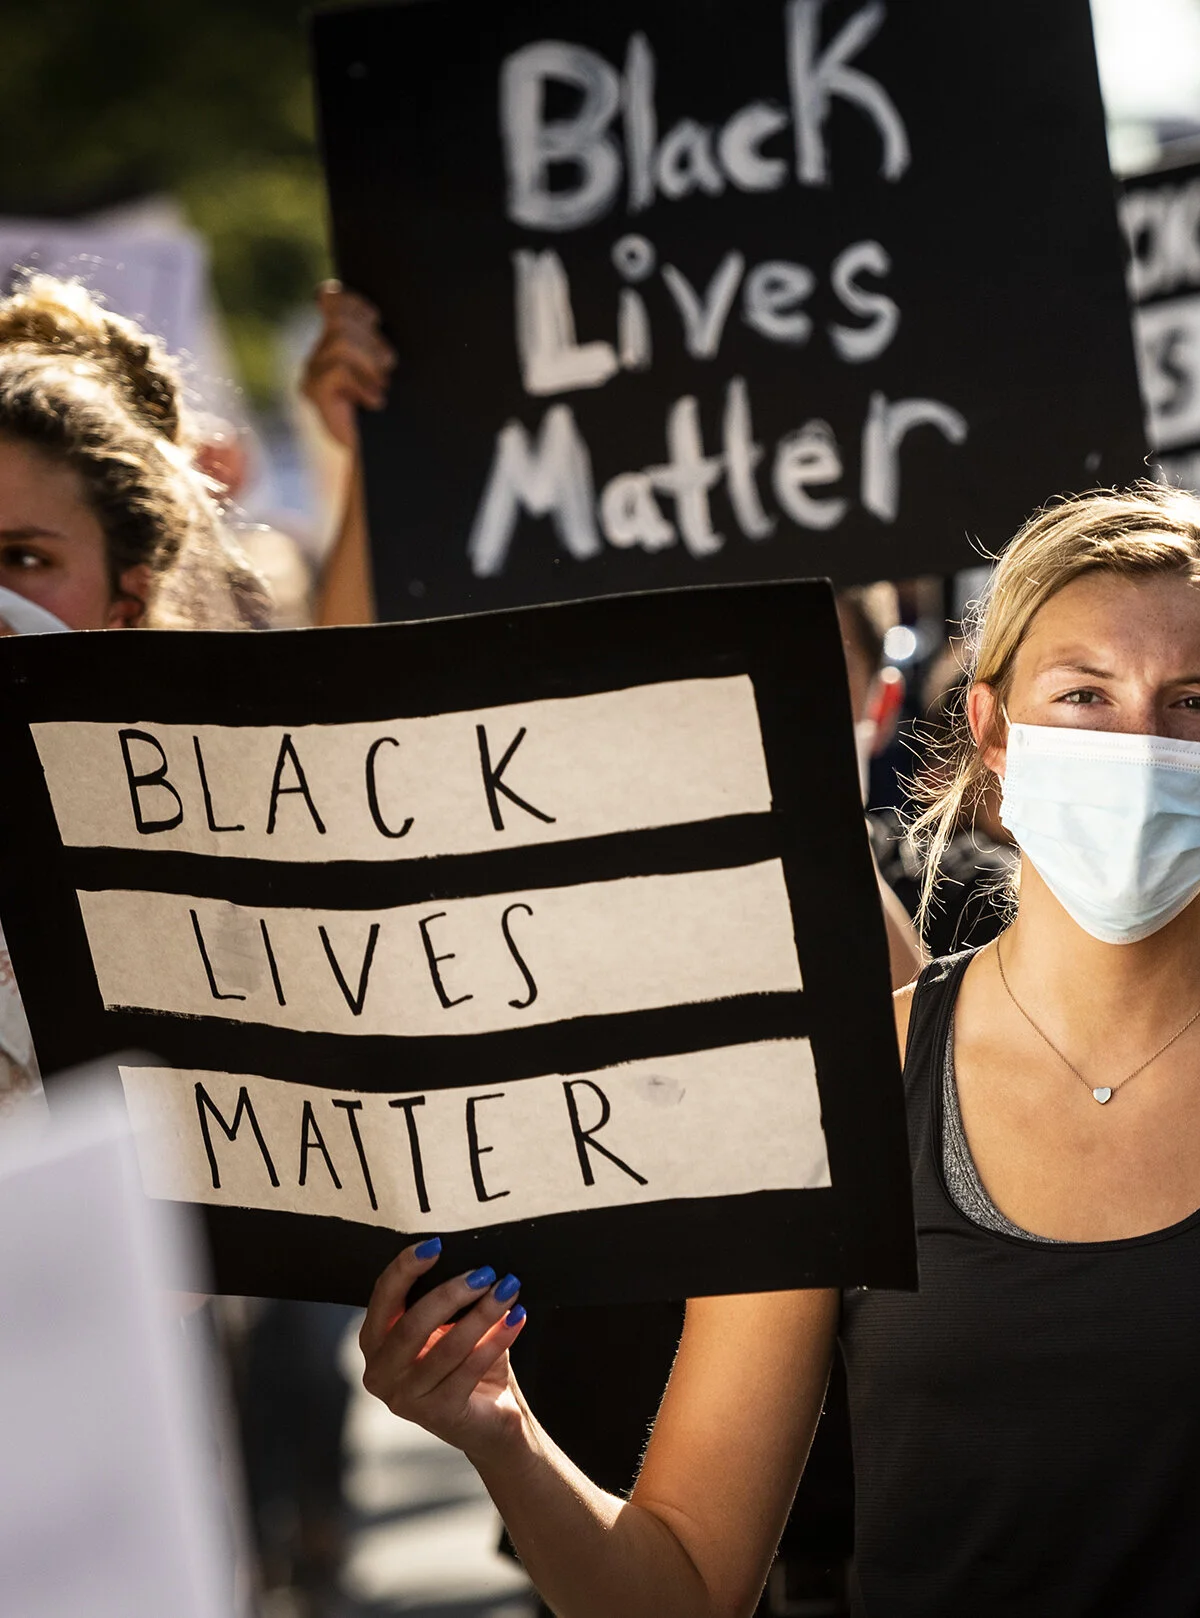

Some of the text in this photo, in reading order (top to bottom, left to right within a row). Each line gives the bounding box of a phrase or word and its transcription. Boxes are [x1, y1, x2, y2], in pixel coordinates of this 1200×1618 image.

[513, 236, 899, 396] Lives
[469, 378, 966, 577] Matter
[118, 727, 556, 838] BLACK
[190, 904, 538, 1015] LIVES
[196, 1081, 648, 1213] MATTER
